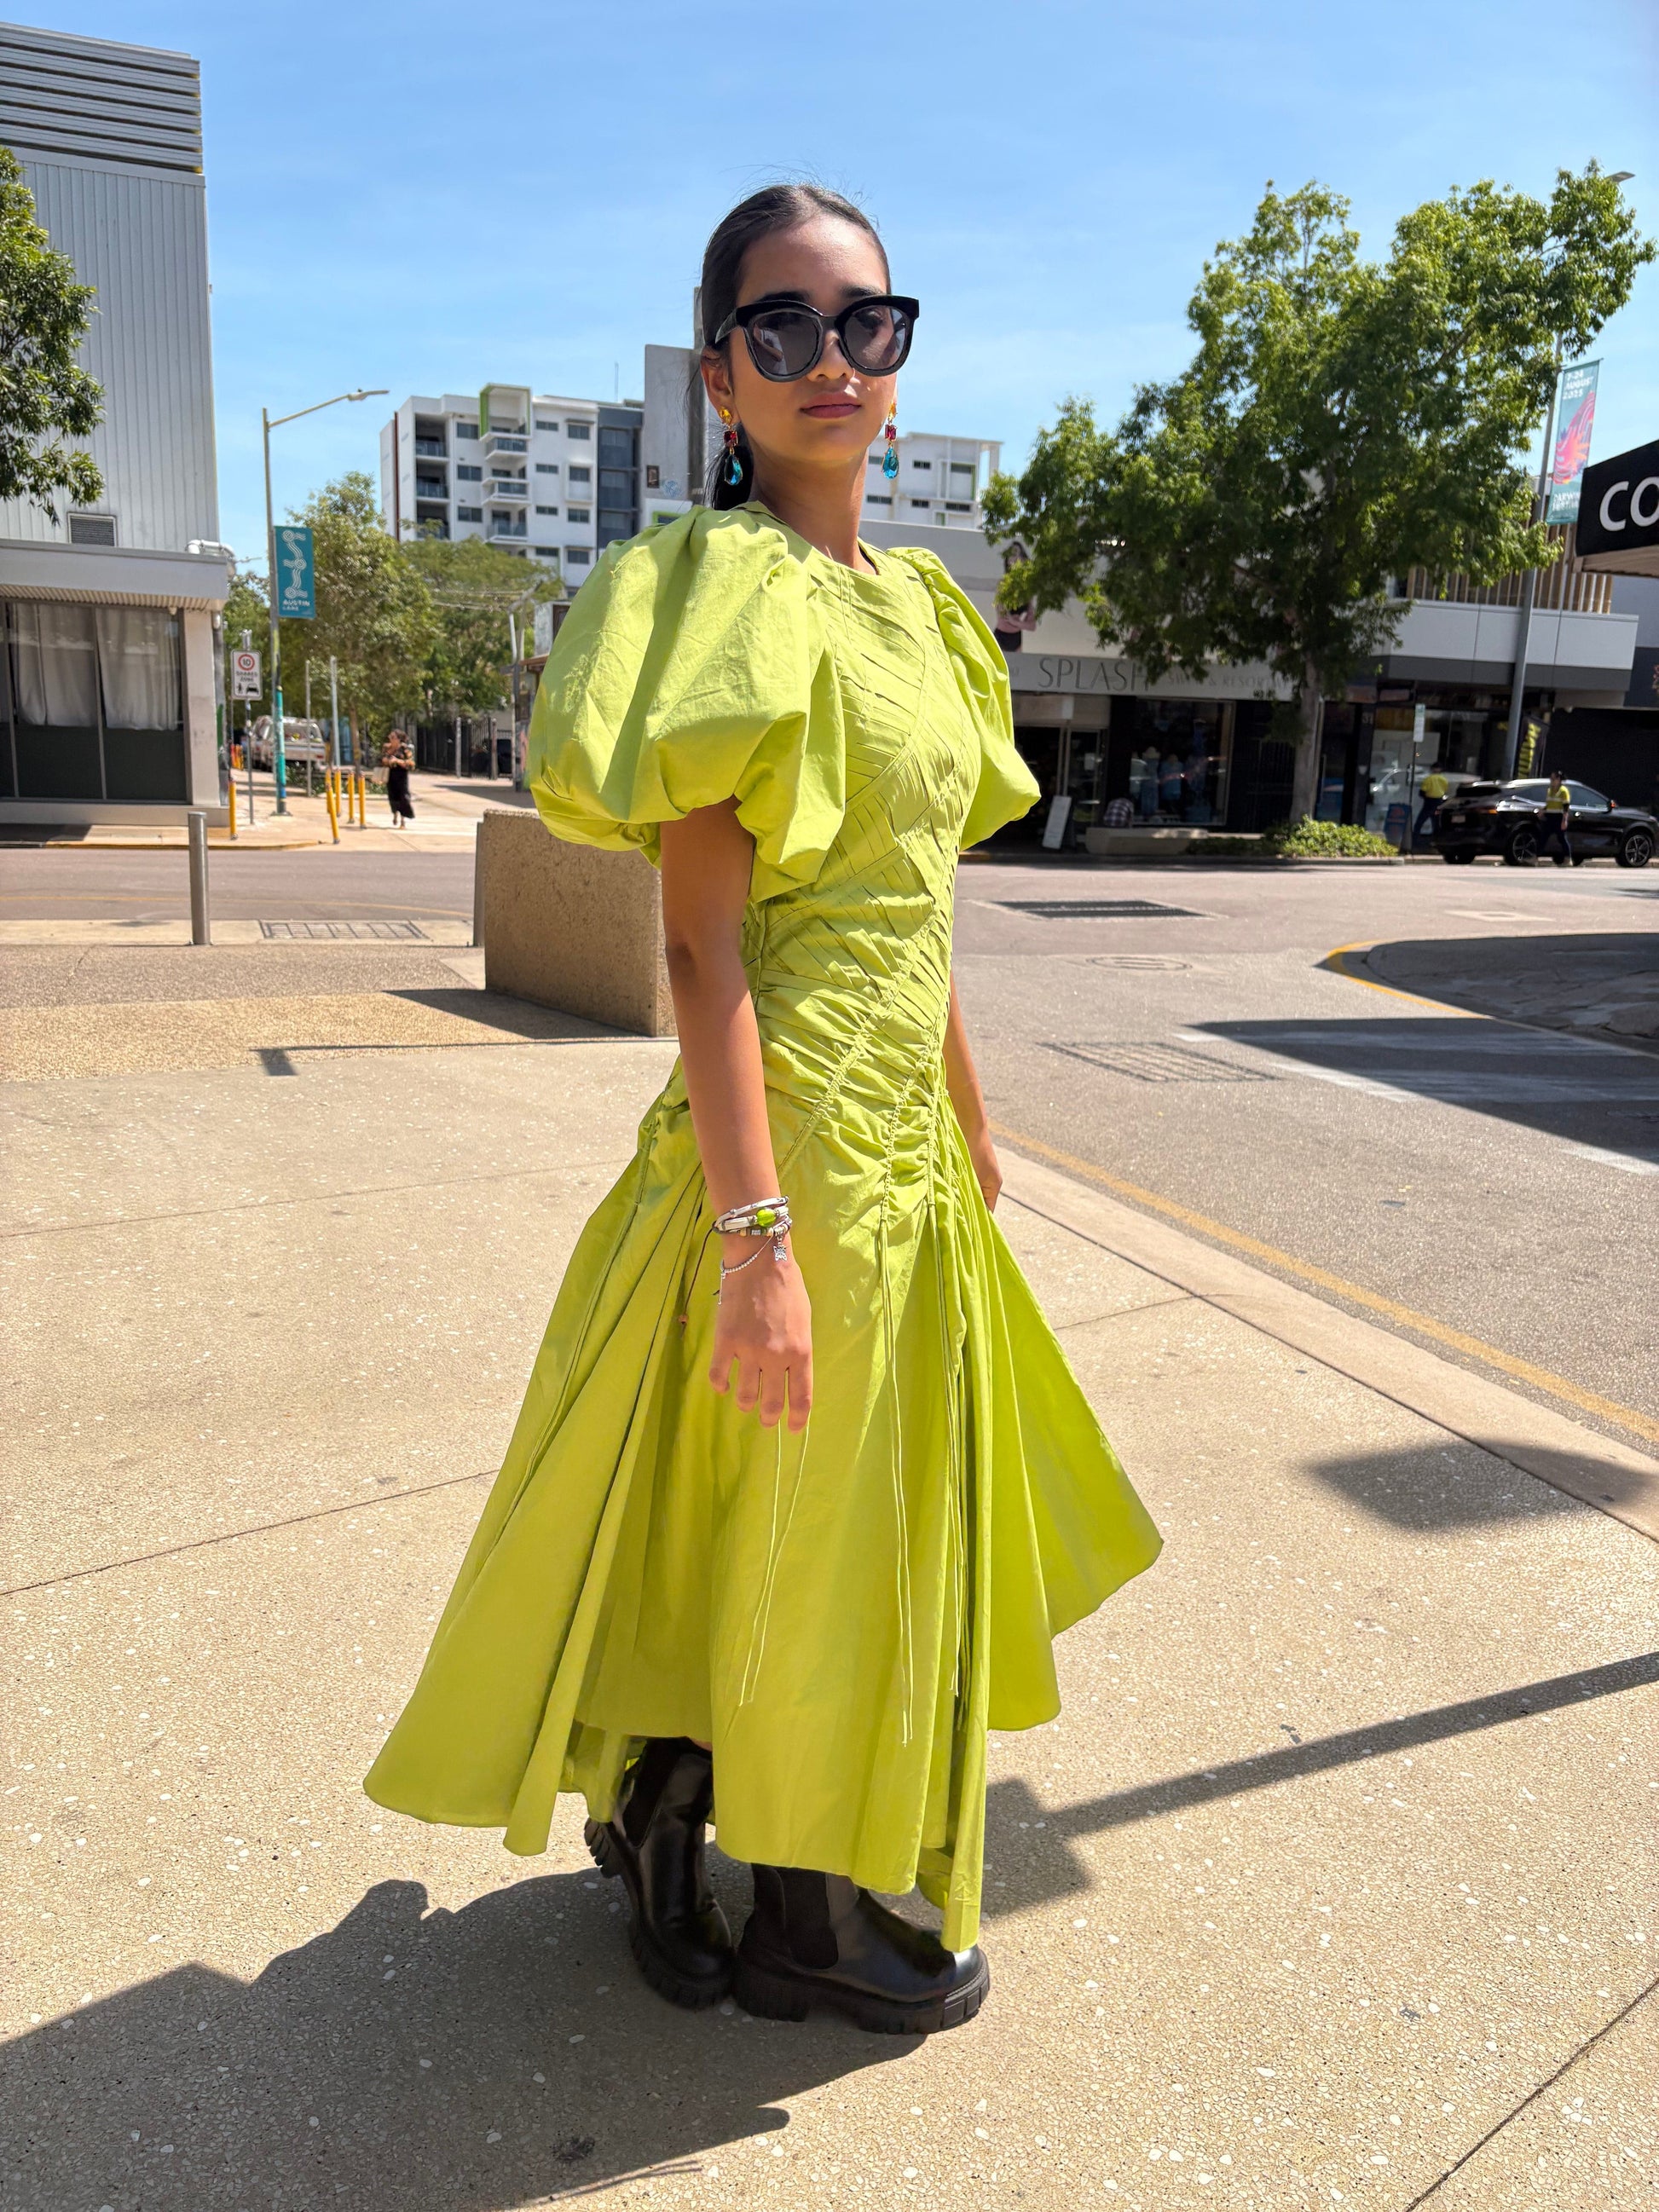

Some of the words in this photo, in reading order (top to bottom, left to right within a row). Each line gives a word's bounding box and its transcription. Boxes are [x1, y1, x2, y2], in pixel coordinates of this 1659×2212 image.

[1564, 376, 1594, 390] AUGUST
[1599, 476, 1659, 532] CO
[243, 658, 251, 667] 10
[1038, 657, 1149, 692] SPLASH
